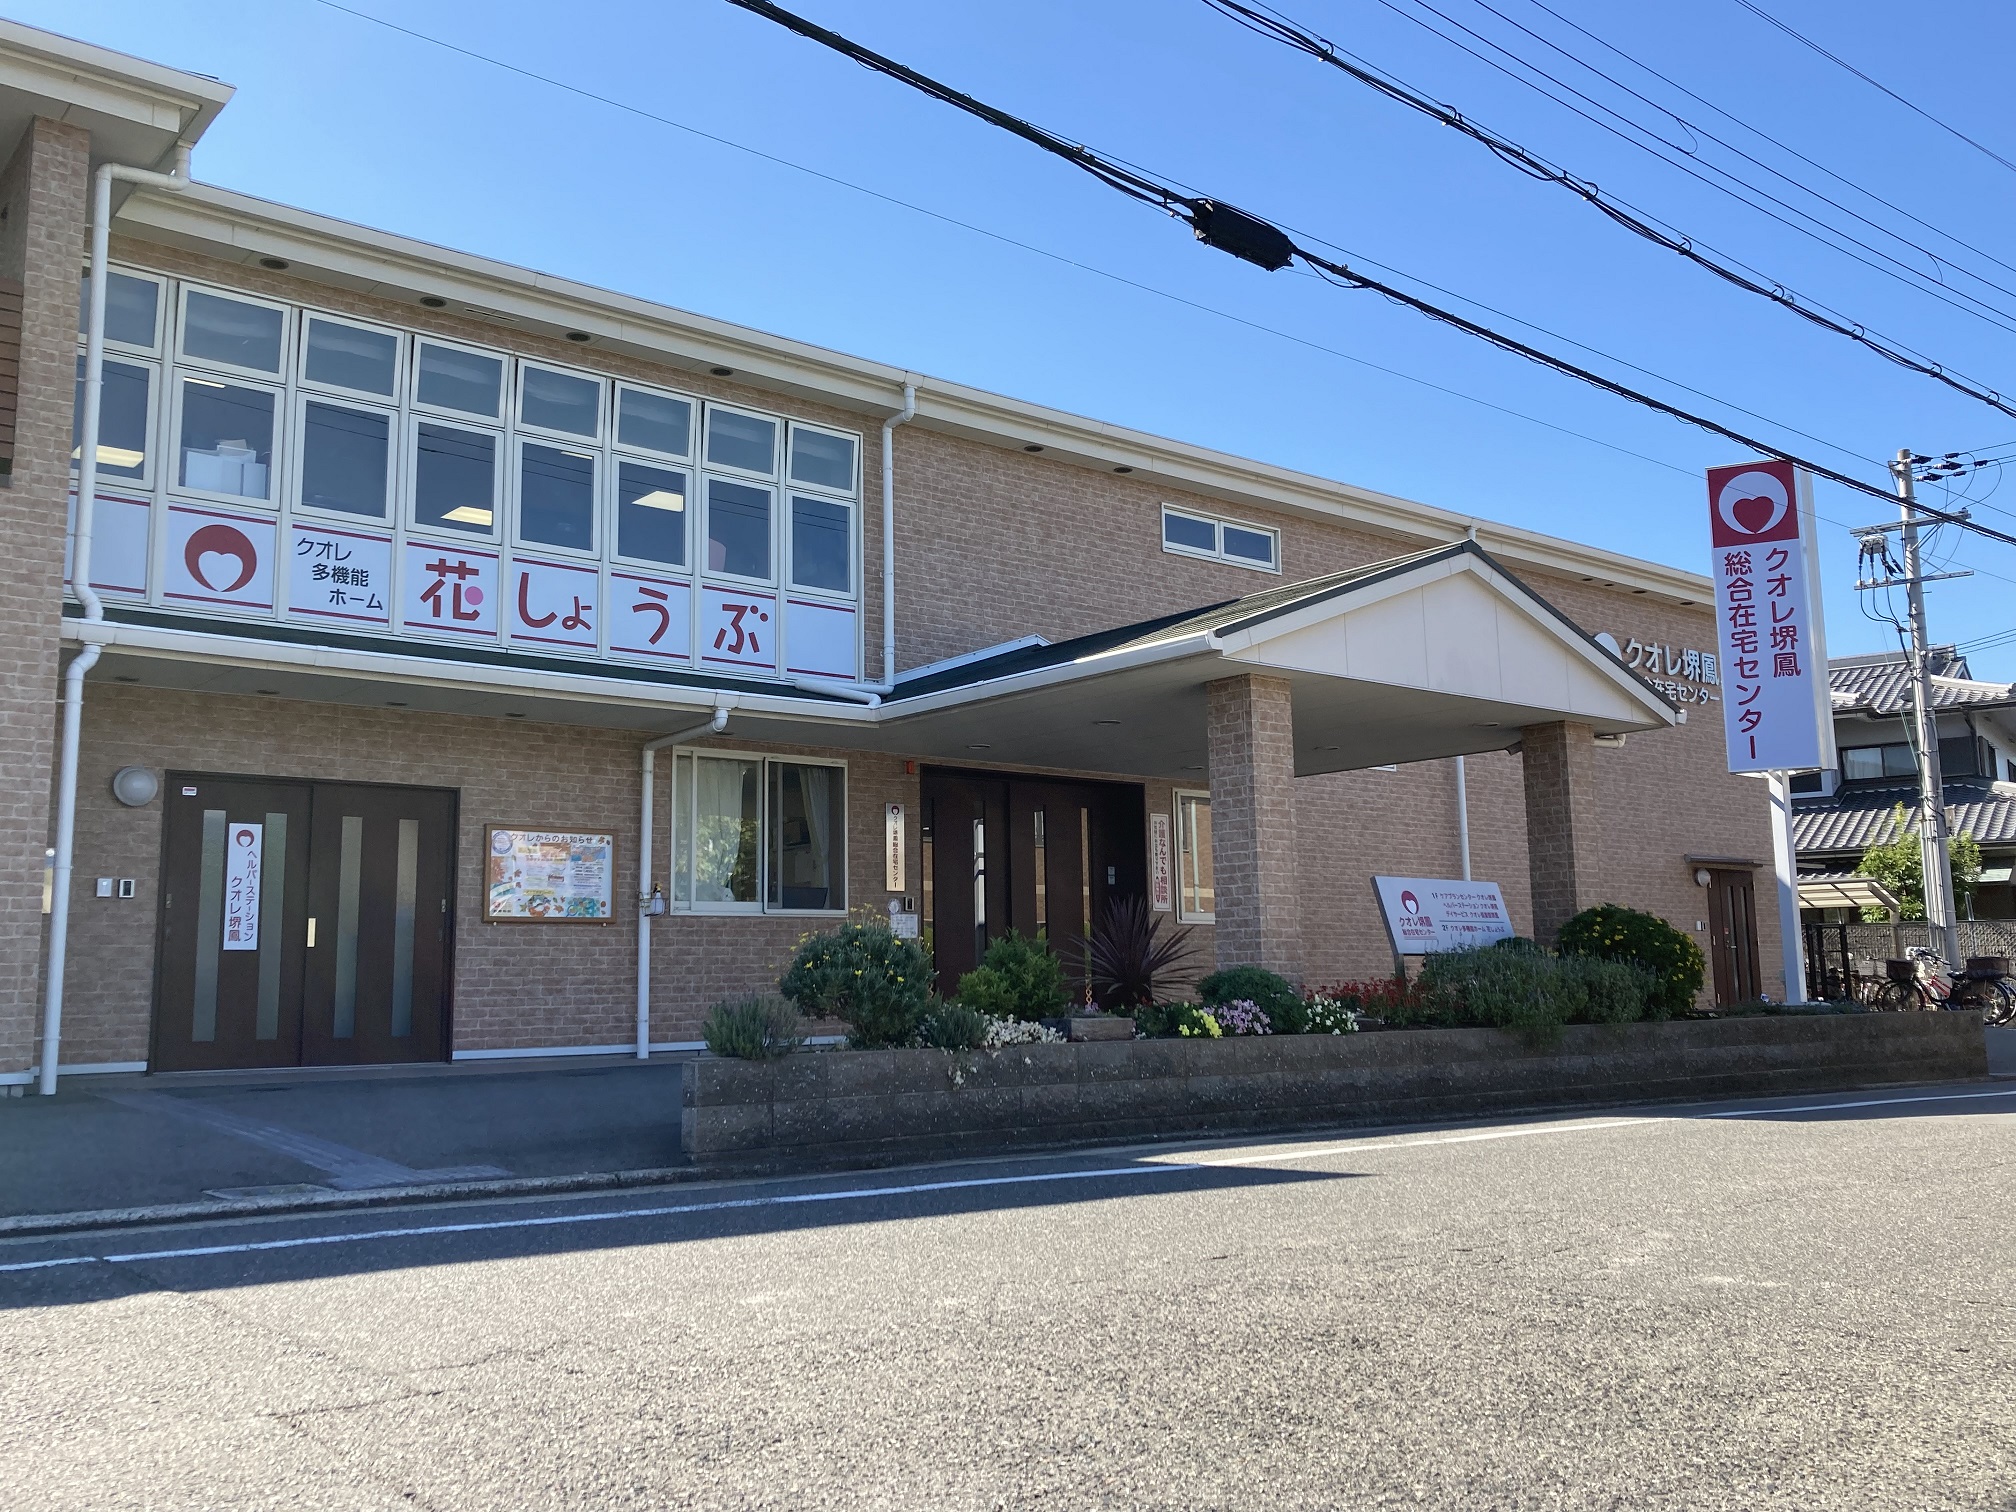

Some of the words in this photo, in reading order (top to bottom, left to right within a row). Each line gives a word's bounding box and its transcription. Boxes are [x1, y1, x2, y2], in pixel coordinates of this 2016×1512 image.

[297, 537, 352, 561] クオレ
[312, 562, 369, 587] 多機能
[329, 588, 384, 611] ホーム
[420, 557, 769, 655] 花しょうぶ
[1765, 547, 1802, 678] クオレ堺鳳
[1624, 637, 1720, 686] クオレ堺鳳
[1724, 550, 1762, 760] 総合在宅センター
[511, 833, 593, 844] クオレからのお知らせ
[228, 876, 243, 942] クオレ堺鳳
[244, 850, 258, 942] ヘルパーステーション
